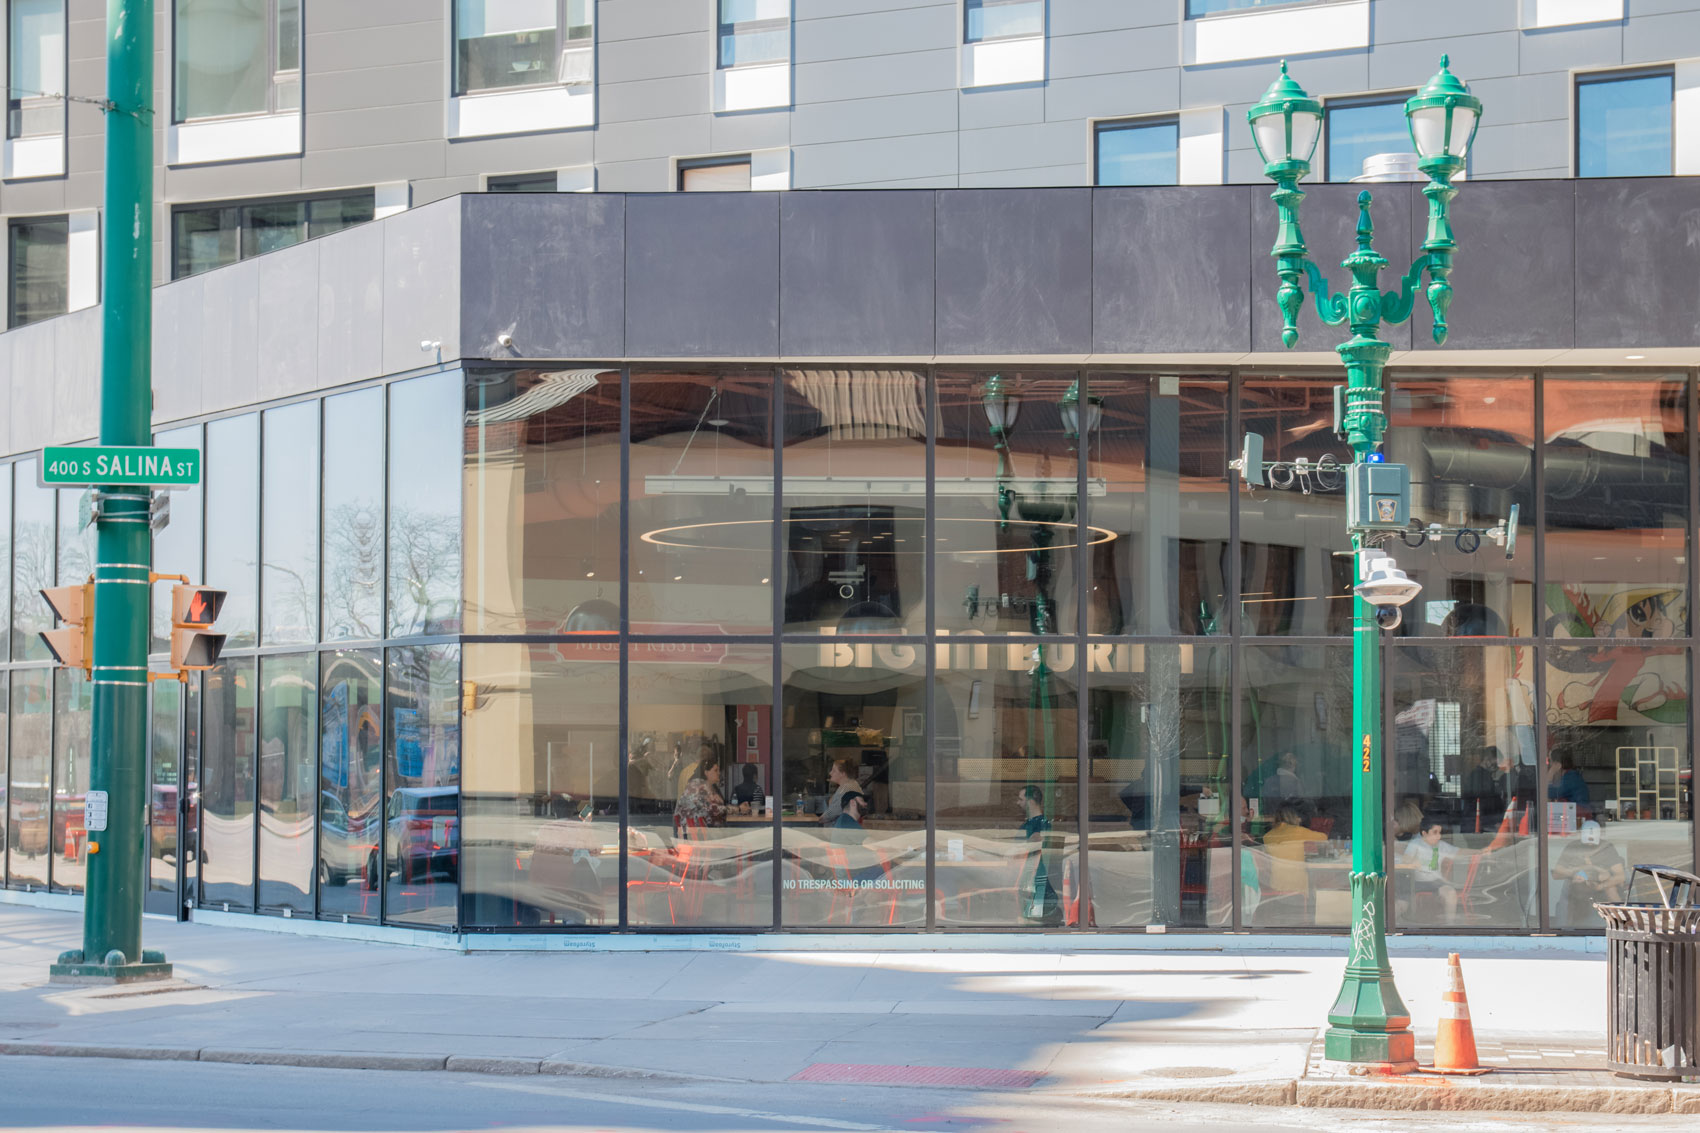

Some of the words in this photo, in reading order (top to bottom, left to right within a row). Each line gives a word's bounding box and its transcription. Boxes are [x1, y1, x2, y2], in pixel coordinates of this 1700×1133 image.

[49, 461, 78, 475] 400
[82, 461, 91, 475] S
[96, 455, 173, 477] SALINA
[177, 462, 194, 477] ST
[1362, 734, 1371, 772] 422
[783, 879, 796, 889] NO
[798, 879, 859, 889] TRESPASSING
[861, 879, 873, 889] OR
[875, 879, 925, 889] SOLICITING
